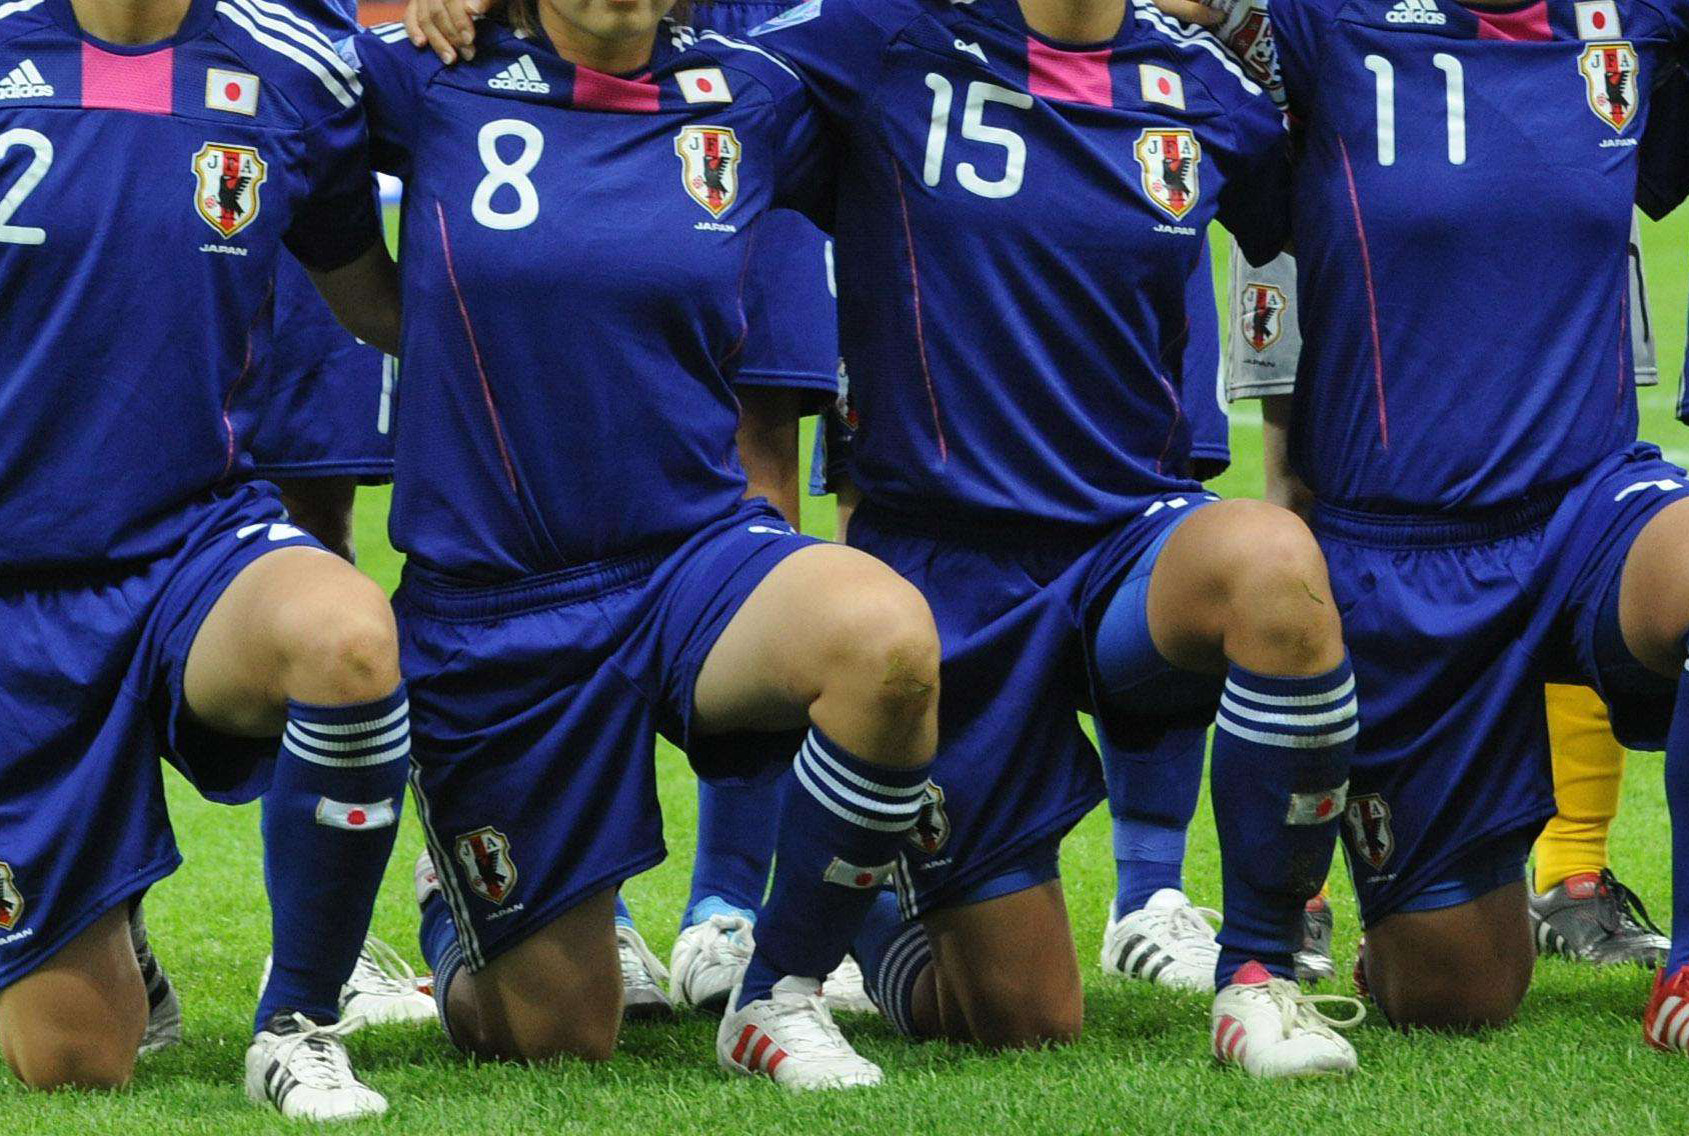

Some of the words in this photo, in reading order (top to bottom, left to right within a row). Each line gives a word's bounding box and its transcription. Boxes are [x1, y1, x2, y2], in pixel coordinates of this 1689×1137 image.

[1385, 8, 1446, 25] adidas
[0, 84, 54, 100] didas
[488, 76, 550, 94] adidas
[1364, 53, 1466, 166] 11
[923, 72, 1034, 199] 15
[1598, 137, 1638, 148] JAPAN
[471, 119, 544, 230] 8
[0, 128, 54, 245] 2
[693, 222, 737, 233] JAPAN
[1153, 224, 1196, 236] JAPAN
[199, 244, 248, 256] JAPAN
[485, 903, 524, 920] JAPAN
[0, 927, 33, 945] APAN
